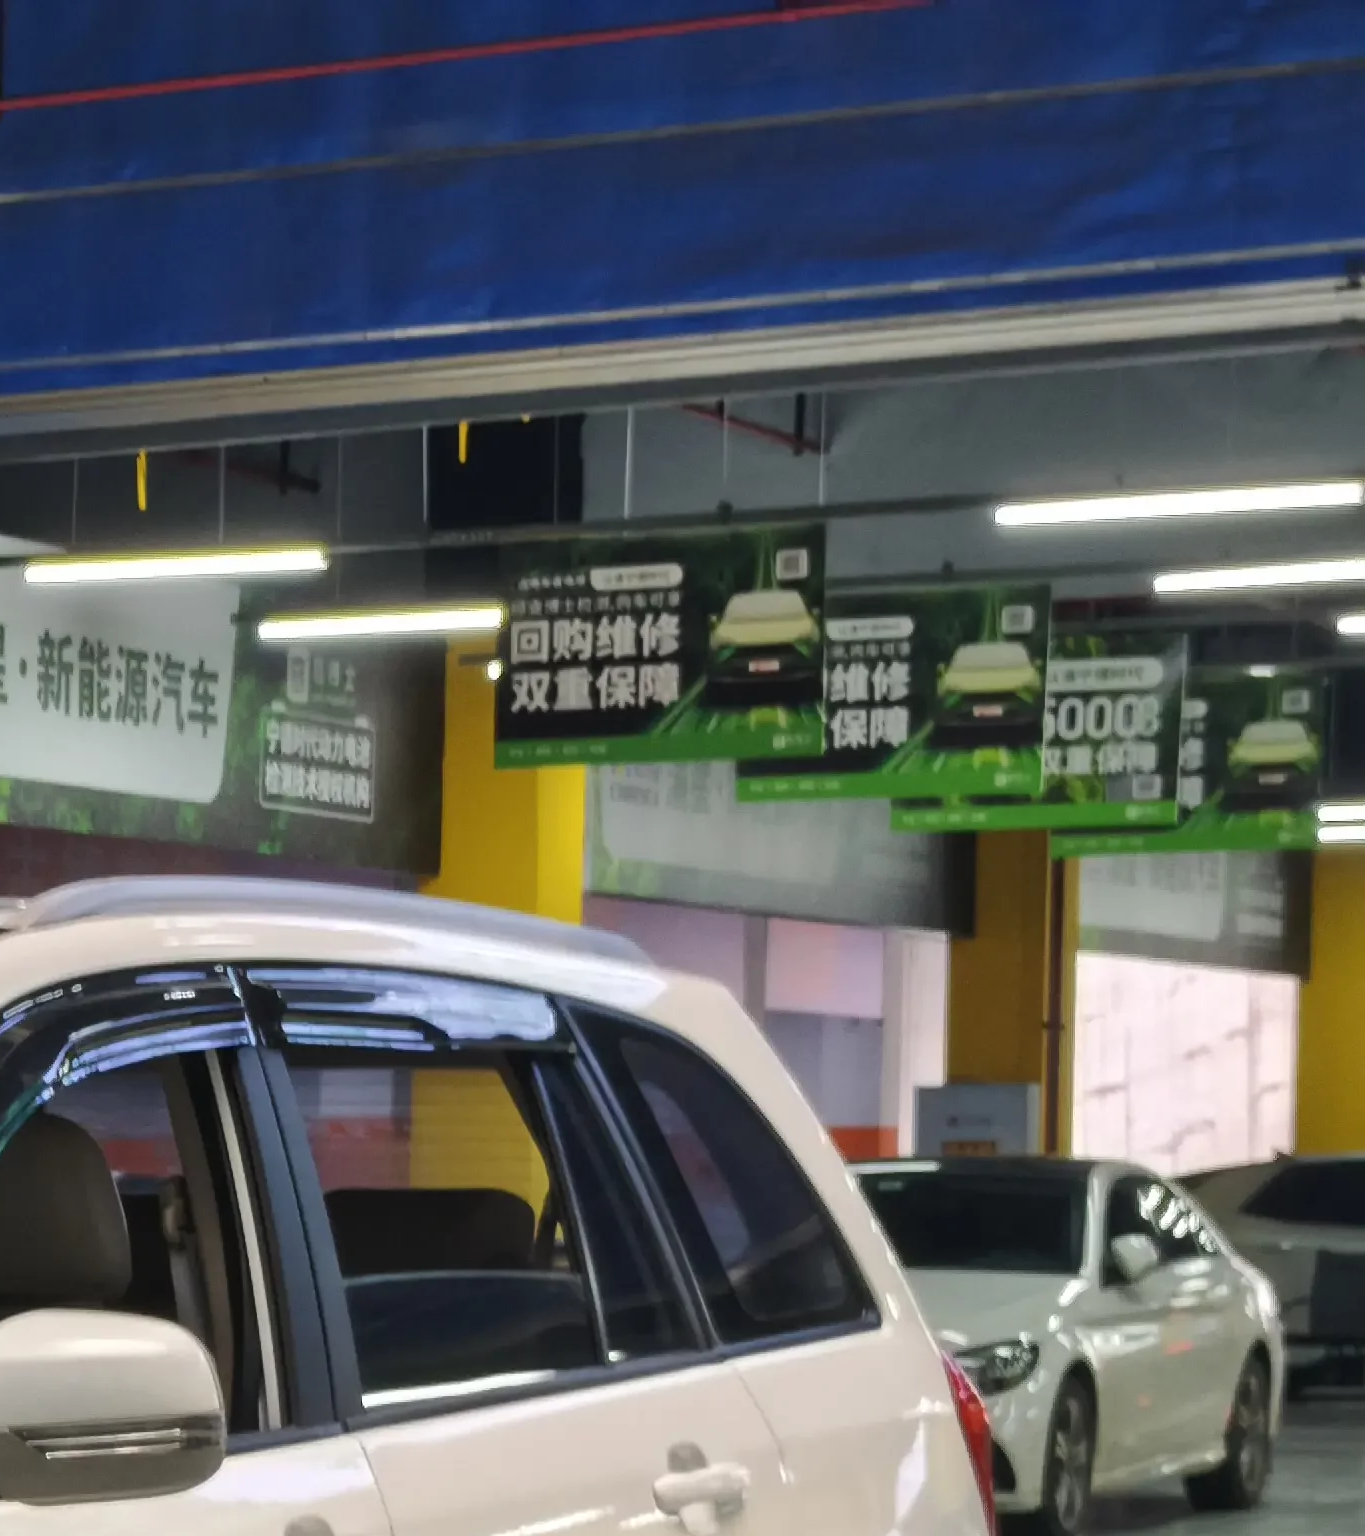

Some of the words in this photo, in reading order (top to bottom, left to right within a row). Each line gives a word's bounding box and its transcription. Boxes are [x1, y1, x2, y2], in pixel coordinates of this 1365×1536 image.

[511, 613, 680, 664] 回购维修
[511, 662, 680, 713] 双重保障
